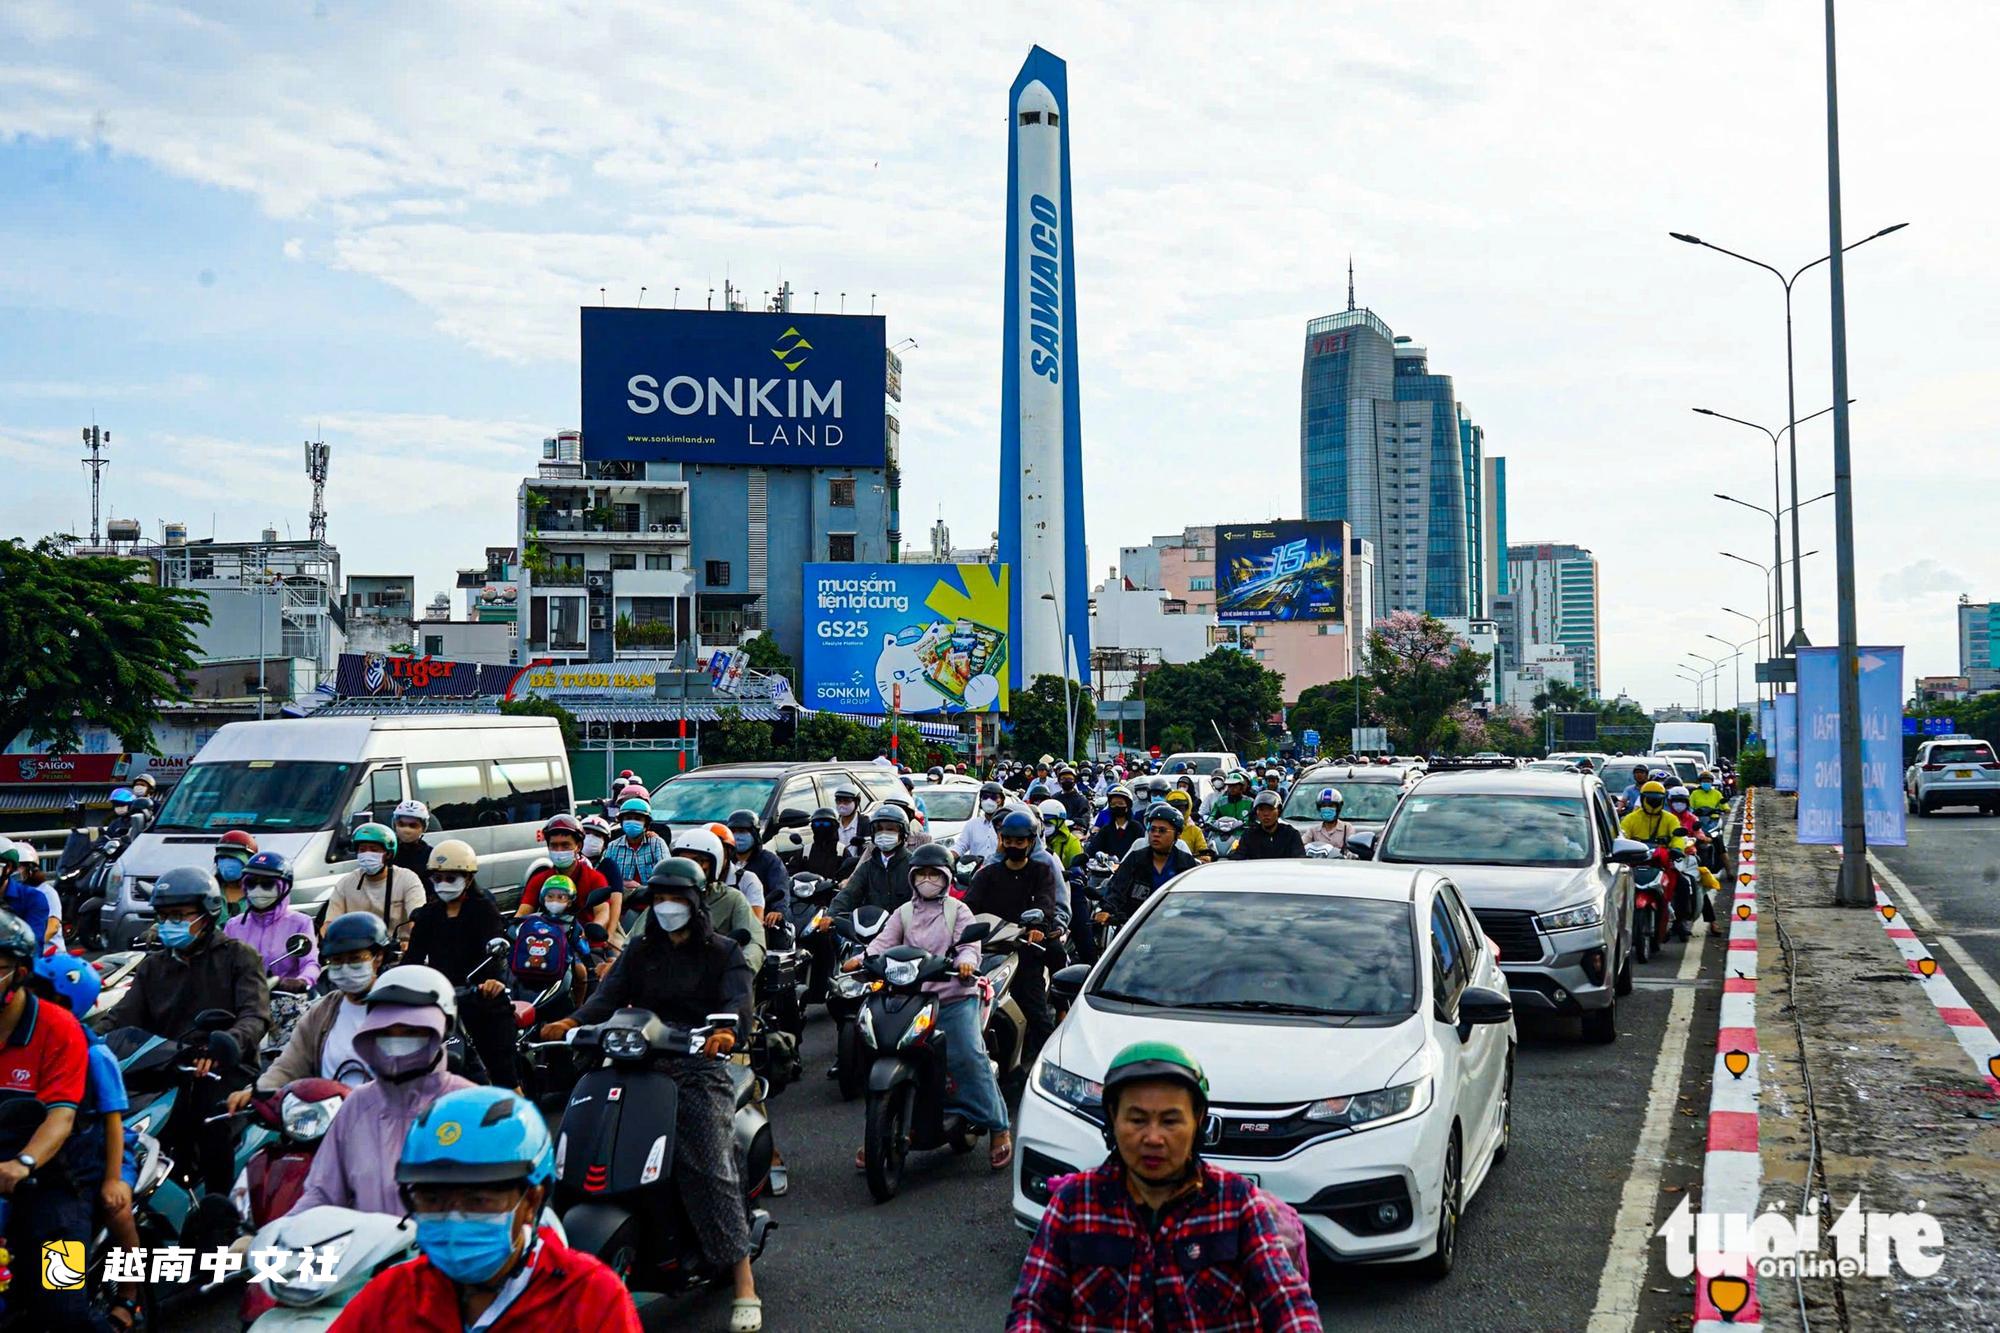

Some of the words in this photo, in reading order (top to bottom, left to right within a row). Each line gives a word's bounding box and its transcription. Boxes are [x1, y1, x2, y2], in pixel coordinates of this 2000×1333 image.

[1030, 193, 1059, 385] SAWACO
[626, 373, 843, 419] SONKIM
[627, 434, 716, 445] www.sonkimland.vn
[748, 423, 844, 447] LAND
[1270, 538, 1308, 579] 15
[818, 578, 858, 592] mua
[859, 572, 896, 592] sắm
[817, 591, 847, 614] tiện
[849, 592, 867, 614] lợi
[868, 591, 909, 613] cùng
[817, 620, 869, 638] GS25
[389, 653, 456, 687] Tiger
[817, 687, 870, 698] SONKIM
[37, 761, 75, 770] SAIGON
[149, 755, 183, 767] QUÁN
